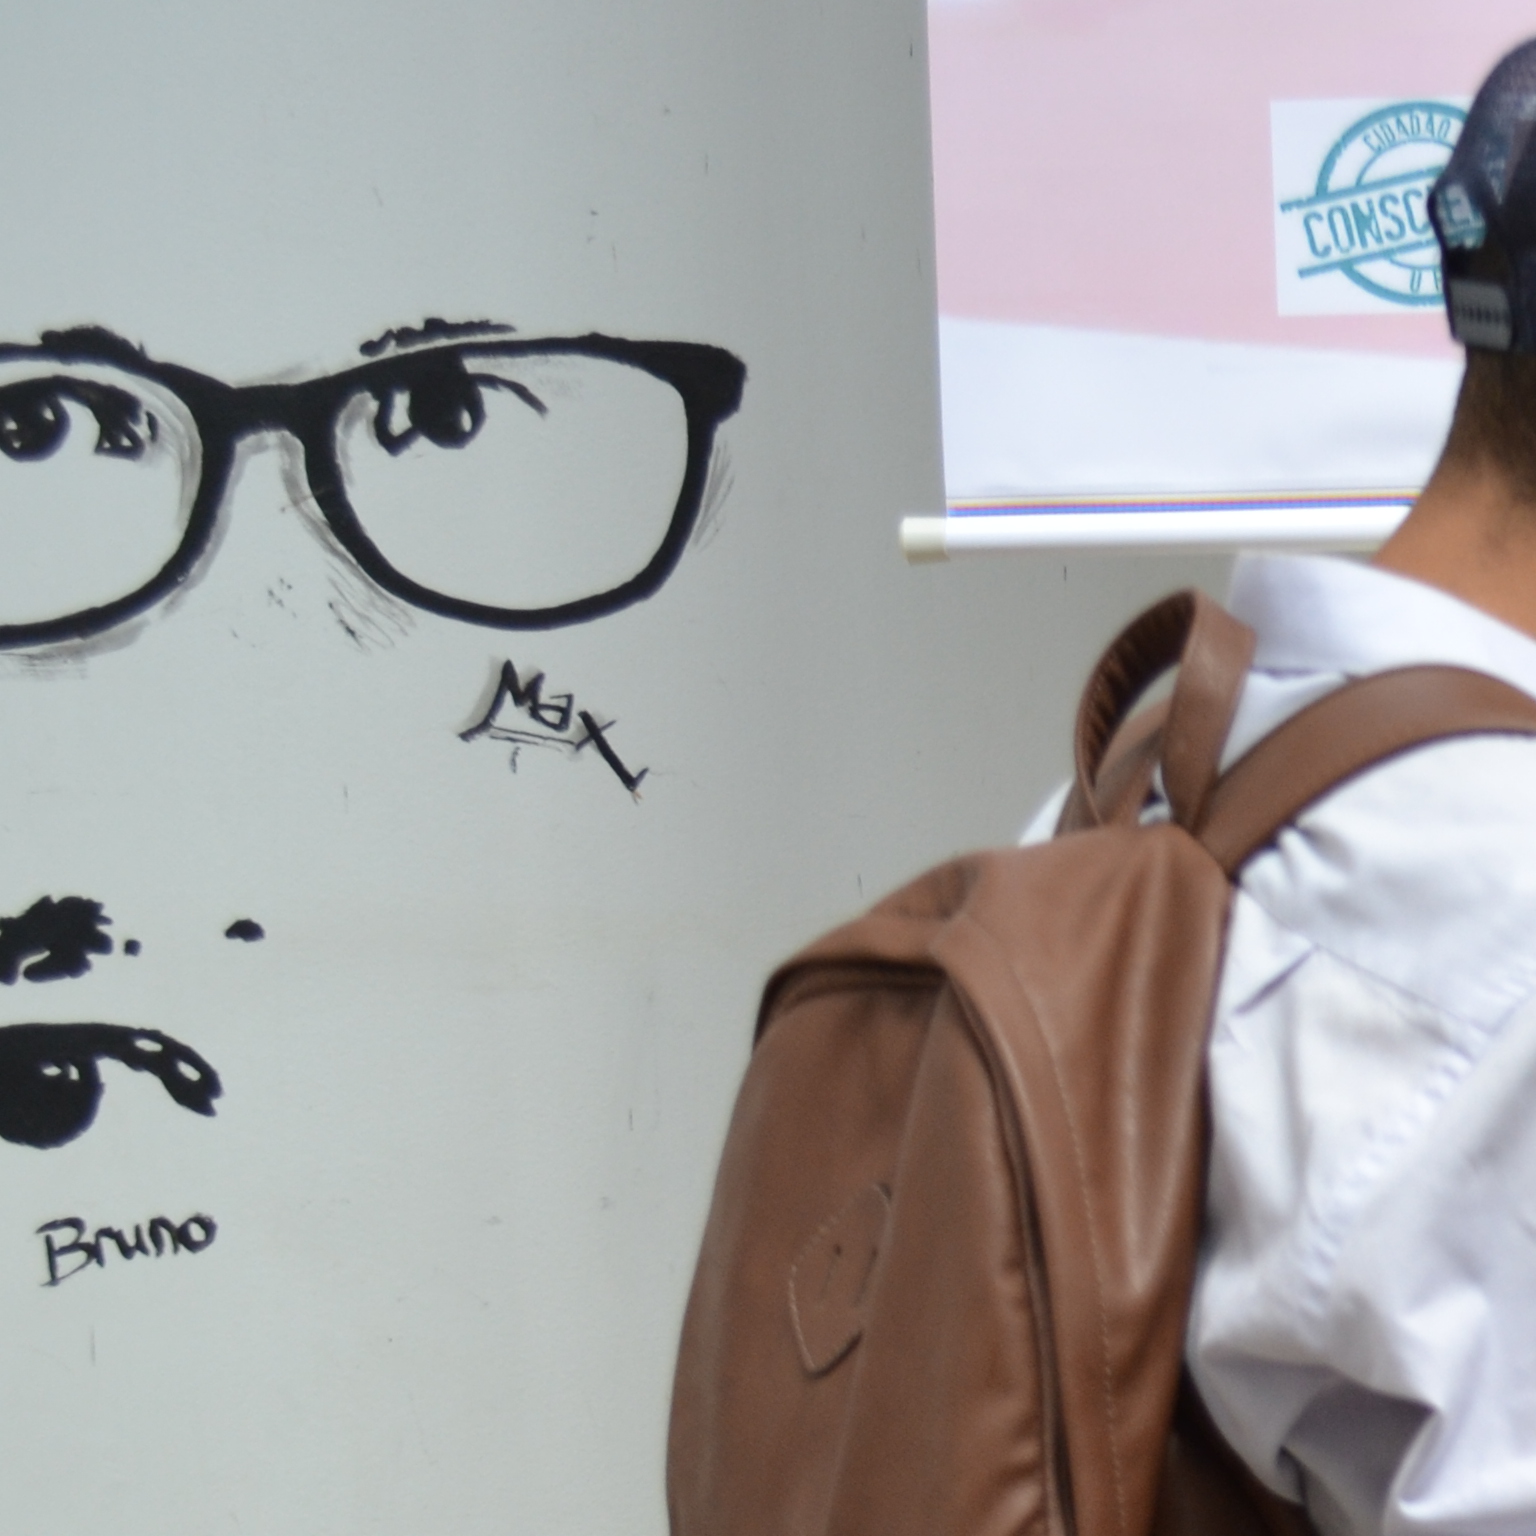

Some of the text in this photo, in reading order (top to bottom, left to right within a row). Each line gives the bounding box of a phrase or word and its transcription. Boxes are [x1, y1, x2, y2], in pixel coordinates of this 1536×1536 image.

[1303, 188, 1431, 259] CONSC
[459, 659, 648, 793] Max
[36, 1214, 217, 1285] Bruno
